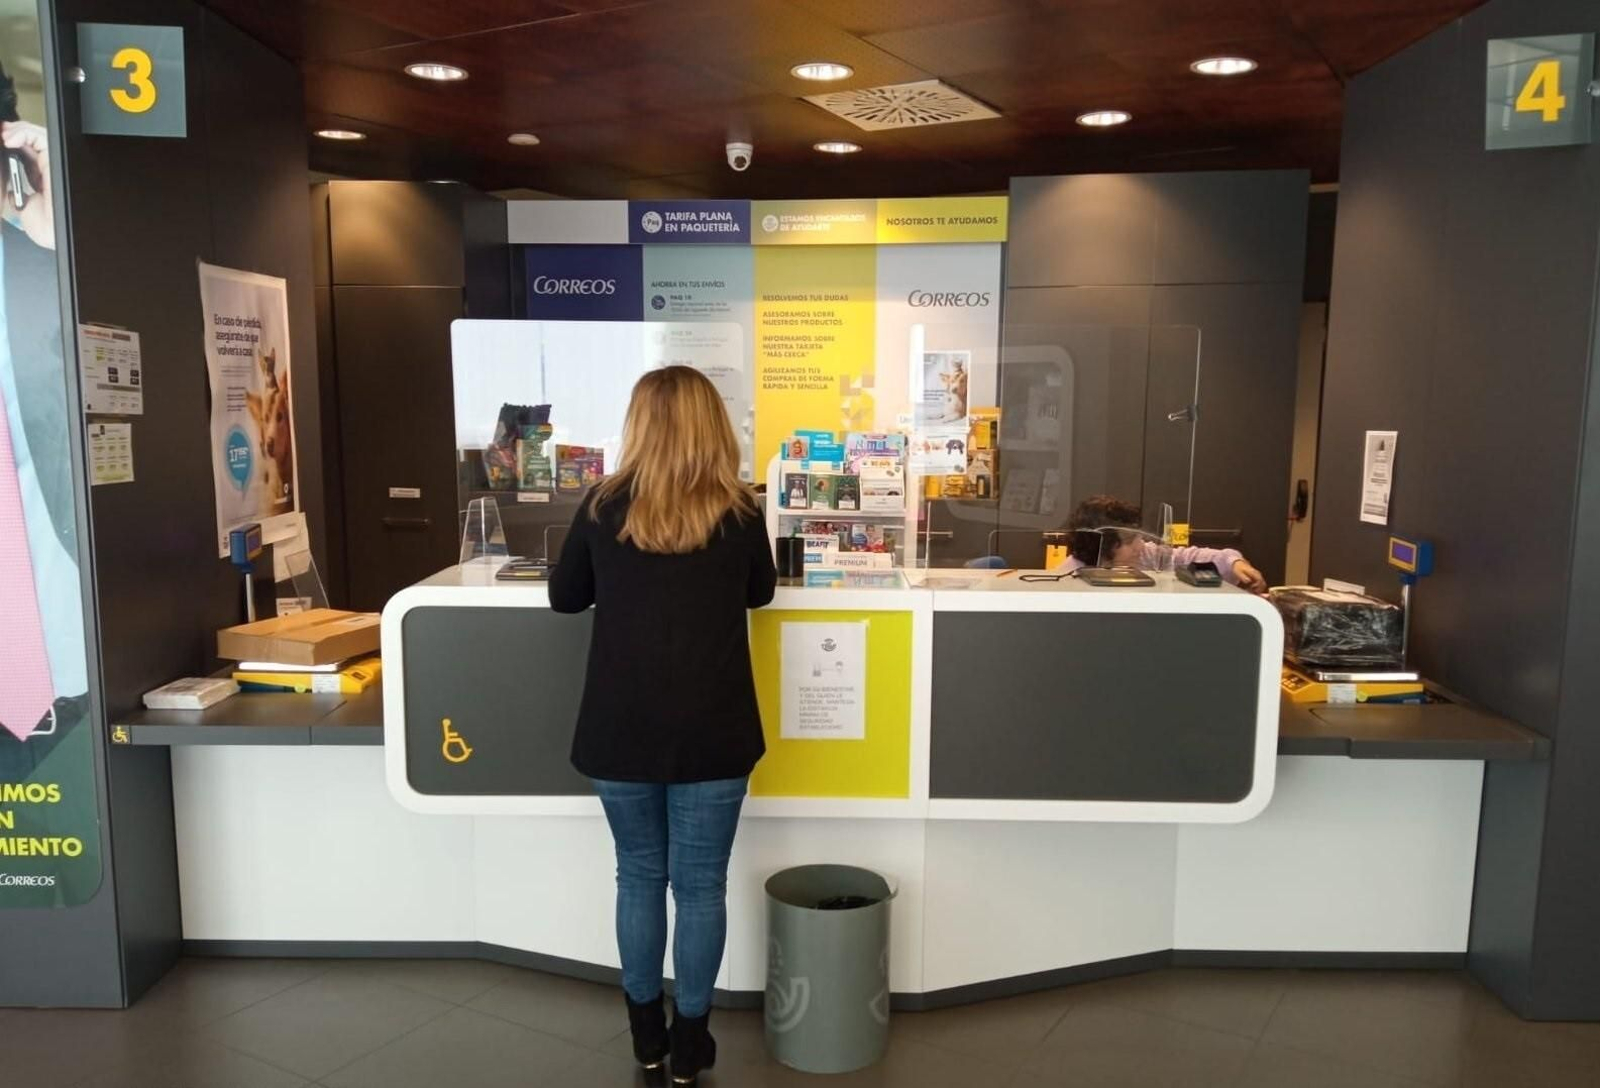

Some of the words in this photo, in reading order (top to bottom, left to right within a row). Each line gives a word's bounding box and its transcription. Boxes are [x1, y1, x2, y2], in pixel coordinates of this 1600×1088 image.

[109, 47, 157, 113] 3
[1515, 60, 1566, 122] 4
[664, 212, 697, 221] TARIFA
[700, 212, 733, 221] PLANA
[886, 218, 934, 226] NOSOTROS
[948, 216, 998, 225] AYUDAMOS
[664, 223, 678, 232] EN
[680, 221, 740, 232] PAQUETERÍA
[533, 275, 616, 295] CORREOS
[908, 289, 992, 308] CORREOS
[0, 783, 61, 803] MOS
